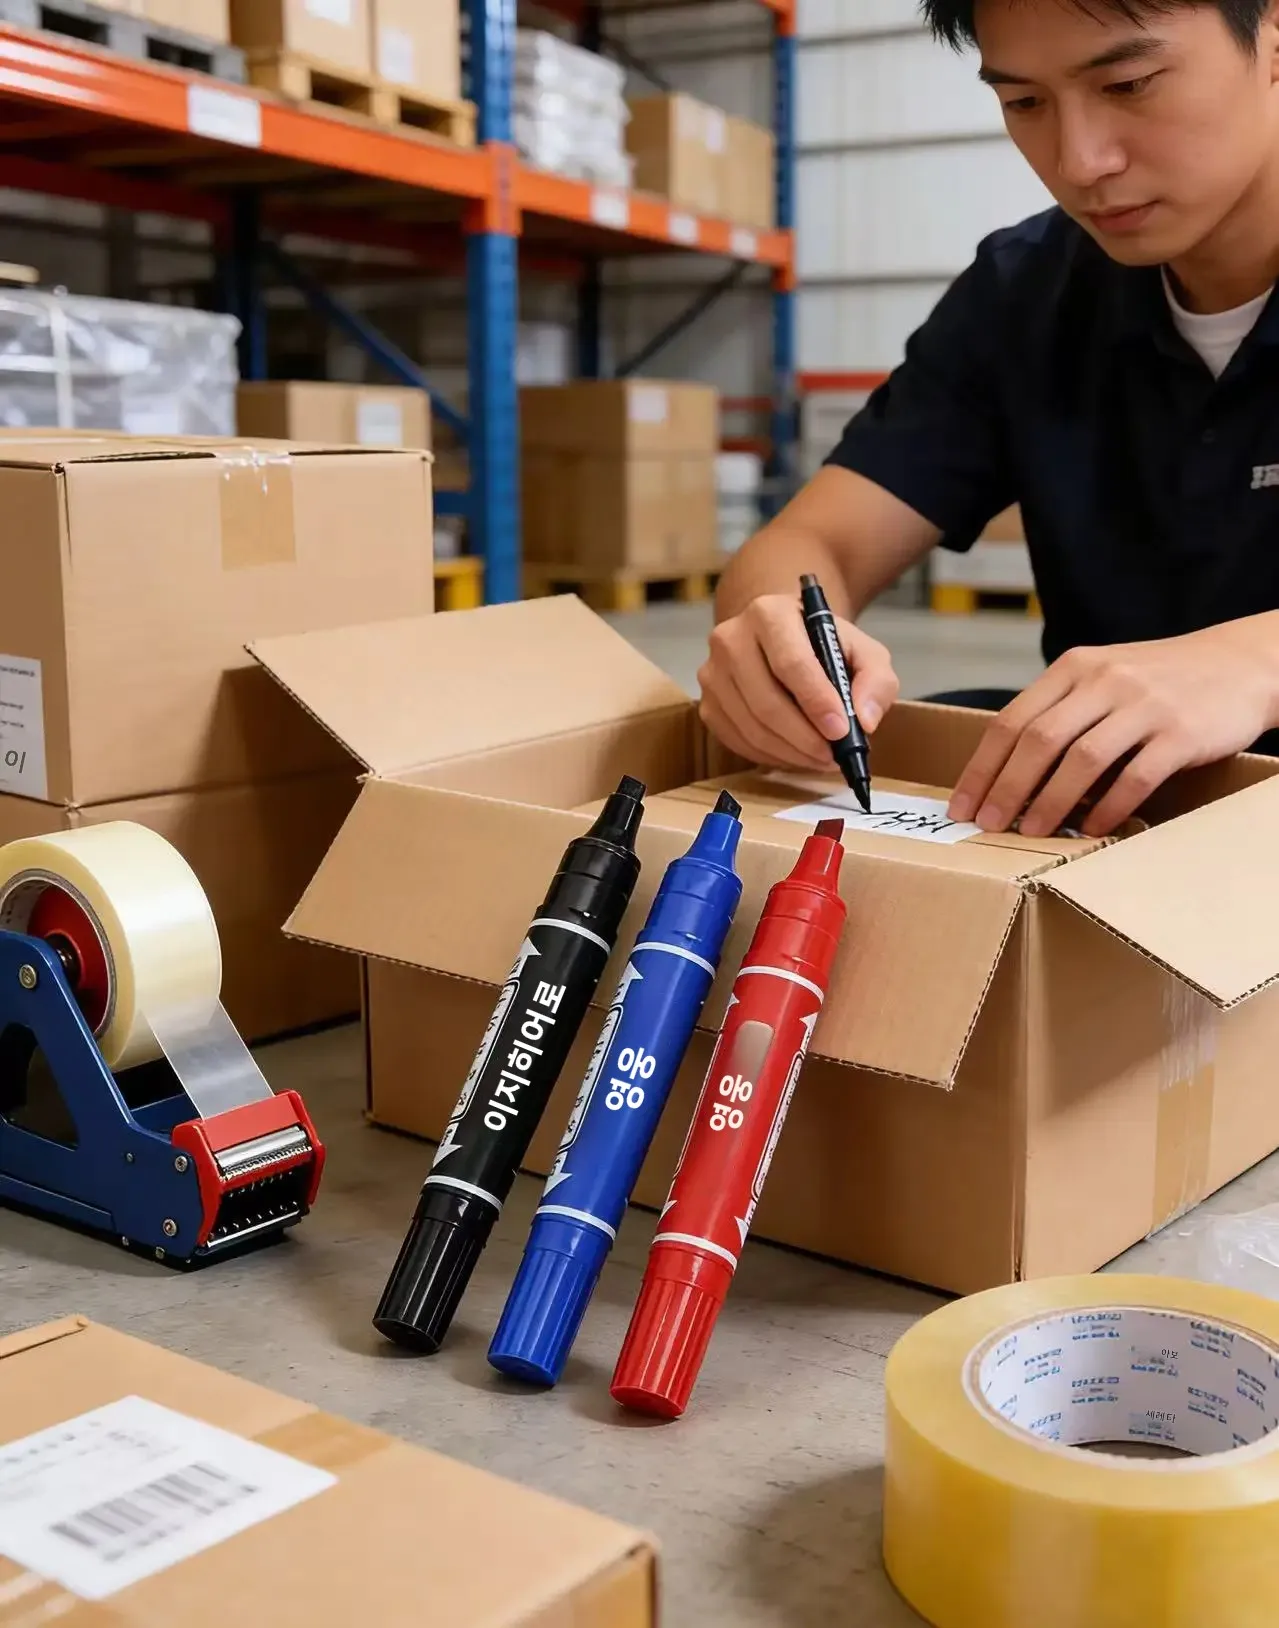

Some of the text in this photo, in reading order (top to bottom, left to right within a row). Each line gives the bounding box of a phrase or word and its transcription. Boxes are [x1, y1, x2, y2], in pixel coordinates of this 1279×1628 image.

[483, 980, 567, 1131] 이지히어로
[605, 1047, 656, 1111] 영웅
[709, 1074, 753, 1131] 영웅
